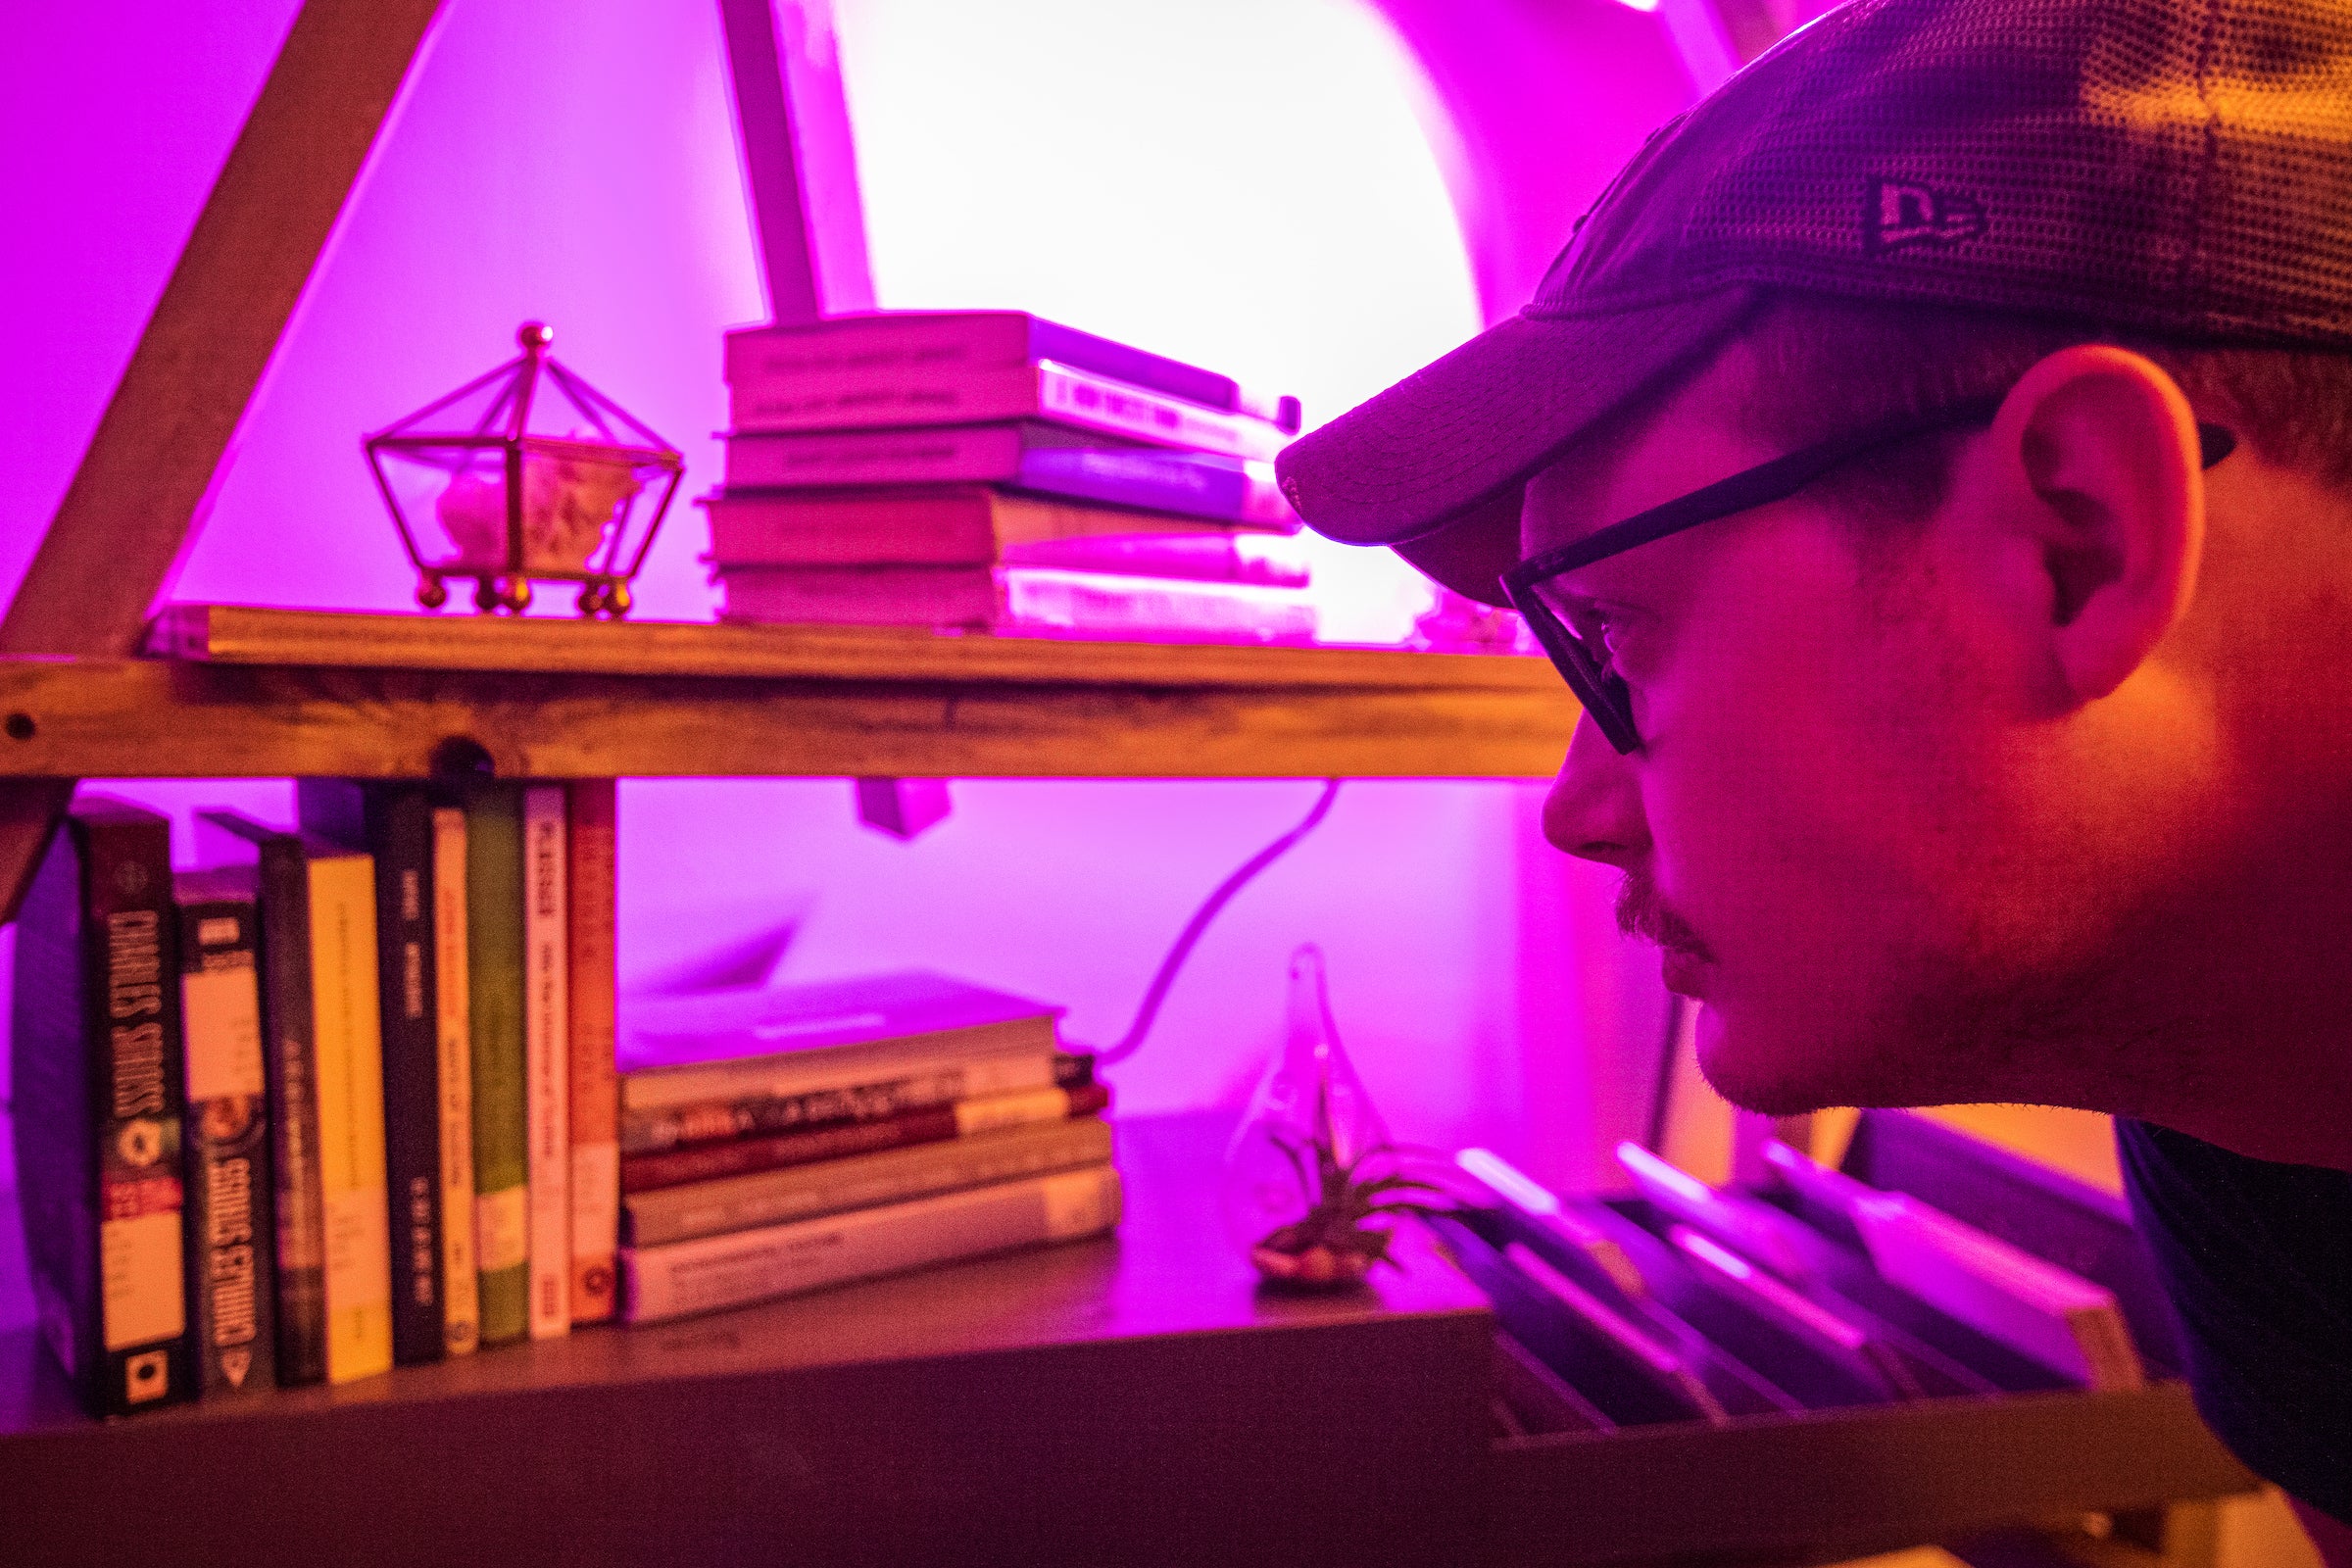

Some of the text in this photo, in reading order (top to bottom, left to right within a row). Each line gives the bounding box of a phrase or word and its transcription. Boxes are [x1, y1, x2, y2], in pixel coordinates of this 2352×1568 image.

[107, 910, 163, 1018] CHARLES
[111, 1021, 165, 1118] STROSS
[212, 1246, 257, 1346] CHARLES
